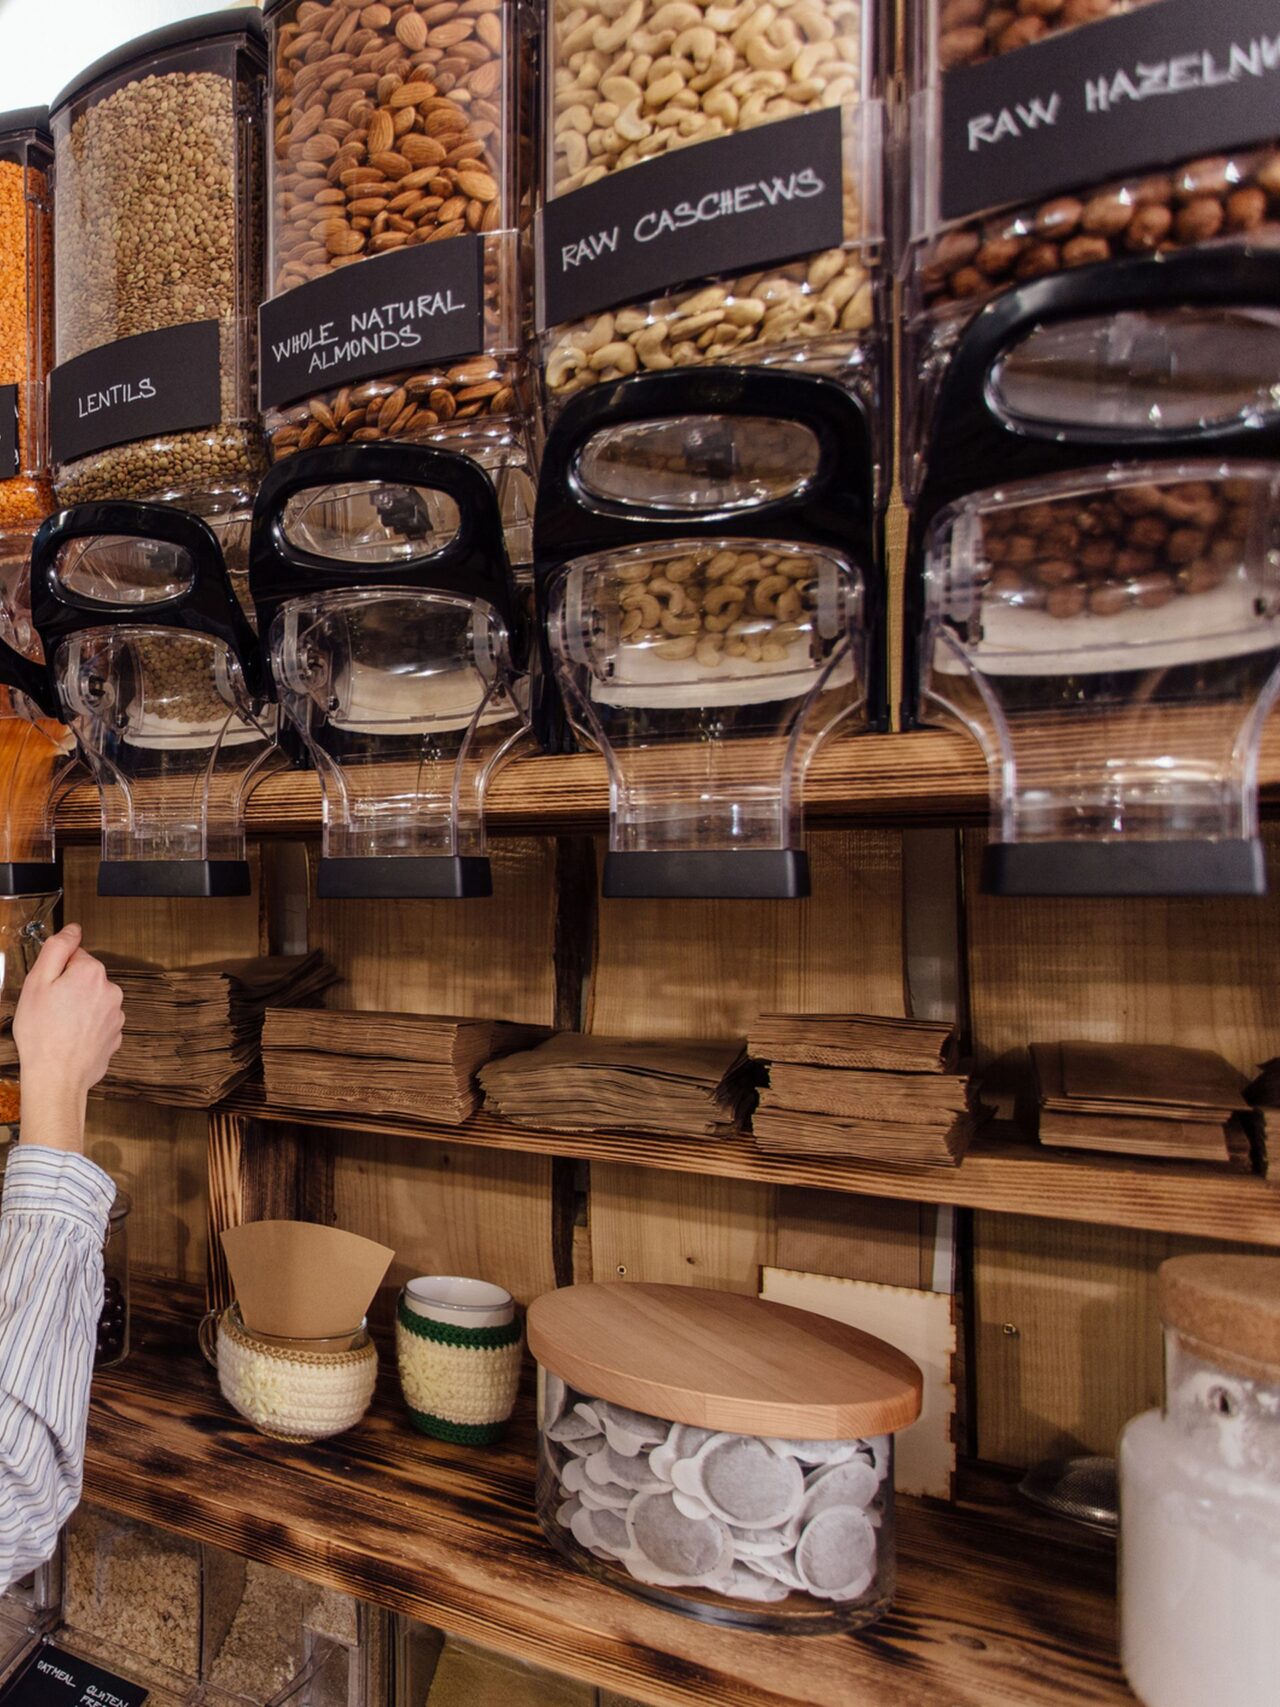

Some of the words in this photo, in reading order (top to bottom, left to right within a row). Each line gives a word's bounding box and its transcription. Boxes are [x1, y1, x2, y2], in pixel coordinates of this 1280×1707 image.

[968, 92, 1061, 151] RAW
[1084, 33, 1280, 113] HAZELNU
[561, 226, 619, 272] RAW
[633, 167, 825, 242] CASCHEWS
[272, 321, 339, 363] WHOLE
[351, 289, 466, 333] NATURAL
[308, 325, 422, 374] ALMONDS
[78, 377, 157, 418] LENTILS
[36, 1660, 76, 1688] OATMEAL
[85, 1685, 129, 1707] GLUTEN
